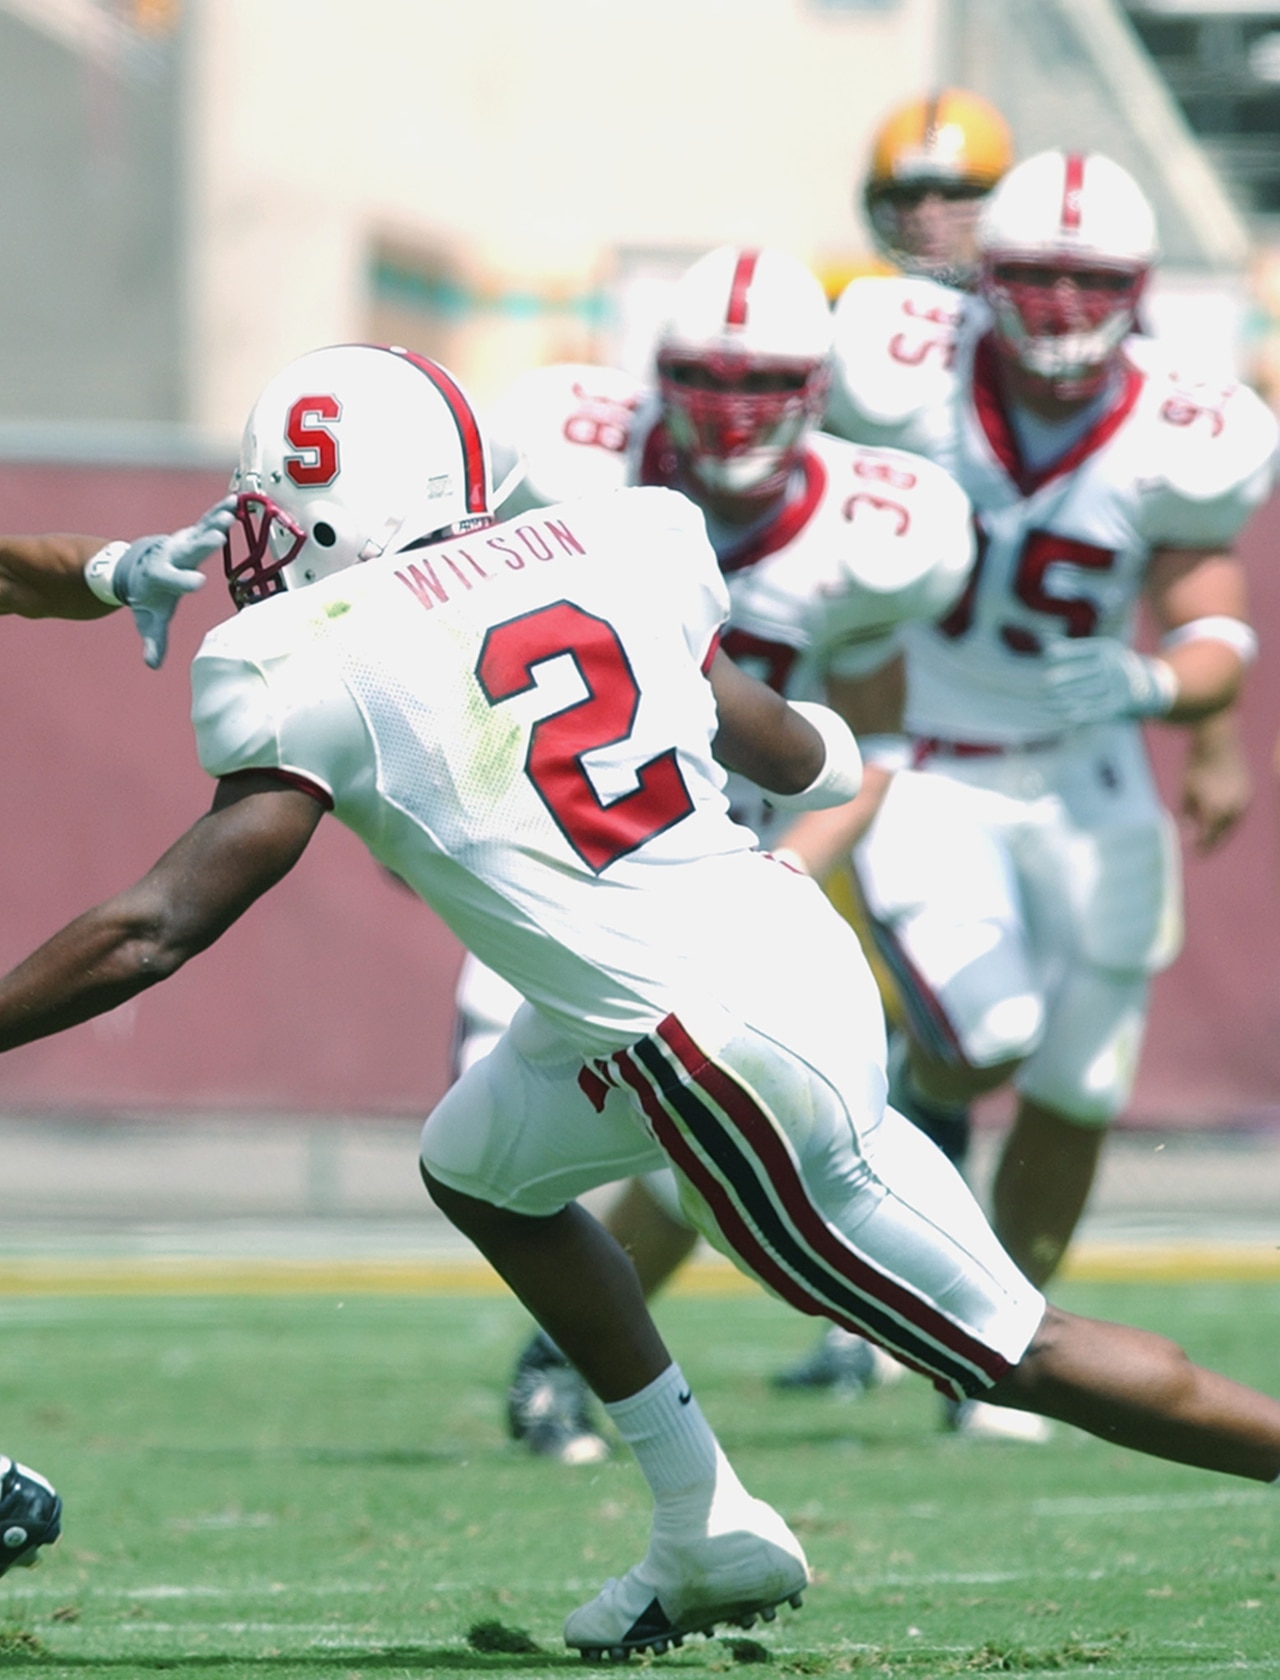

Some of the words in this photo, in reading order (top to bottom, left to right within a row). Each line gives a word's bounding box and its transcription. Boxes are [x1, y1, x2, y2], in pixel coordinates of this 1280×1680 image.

[283, 392, 343, 488] S
[841, 450, 917, 537] 38
[394, 517, 588, 612] WILSON
[474, 598, 696, 876] 2
